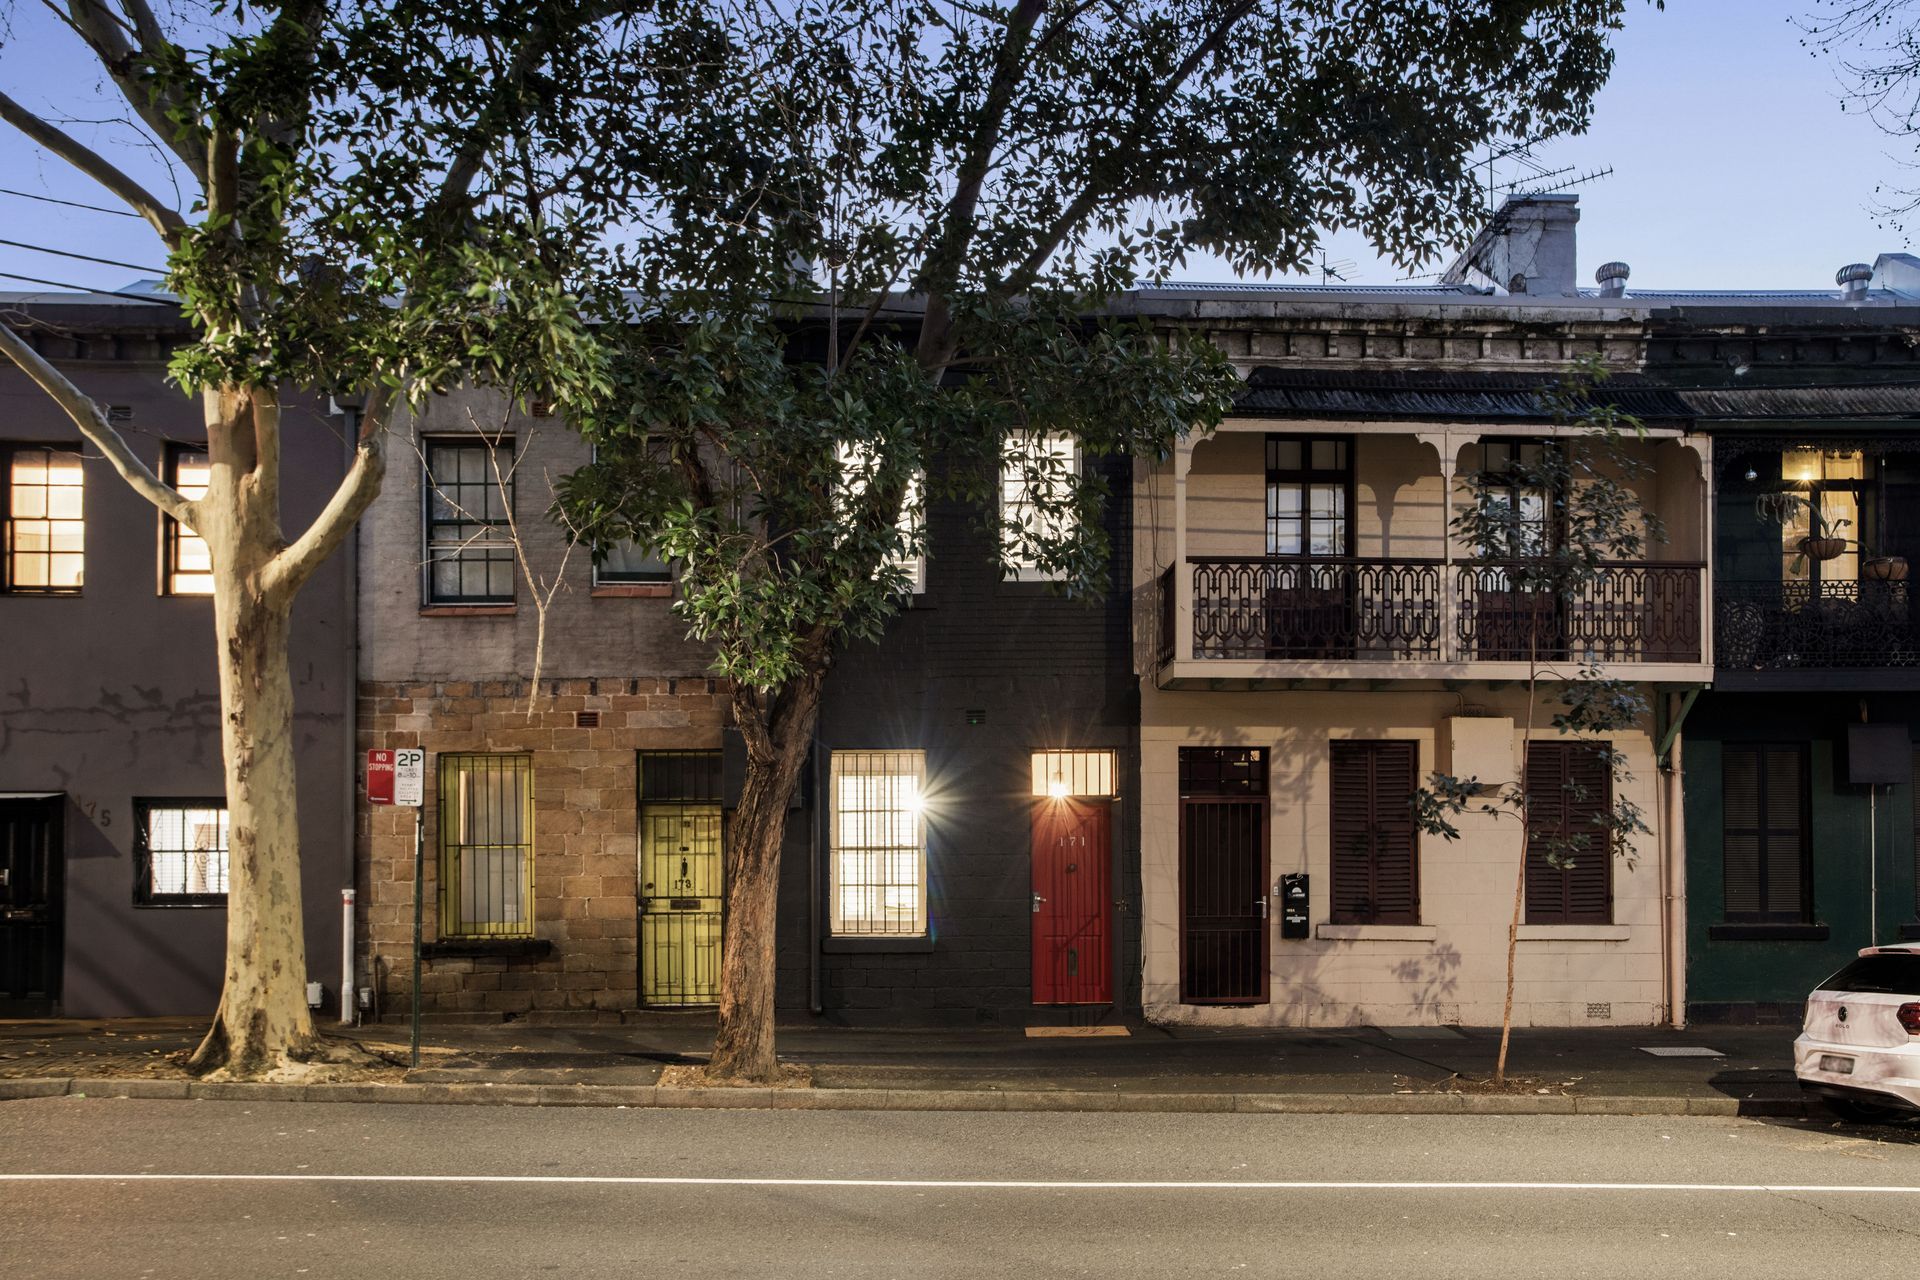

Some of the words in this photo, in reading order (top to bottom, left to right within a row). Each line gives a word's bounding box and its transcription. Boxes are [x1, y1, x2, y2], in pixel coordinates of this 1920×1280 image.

[375, 752, 387, 762] NO
[397, 753, 421, 767] 2P
[368, 763, 394, 771] STOPPING
[1060, 836, 1085, 847] 171
[674, 879, 692, 890] 173
